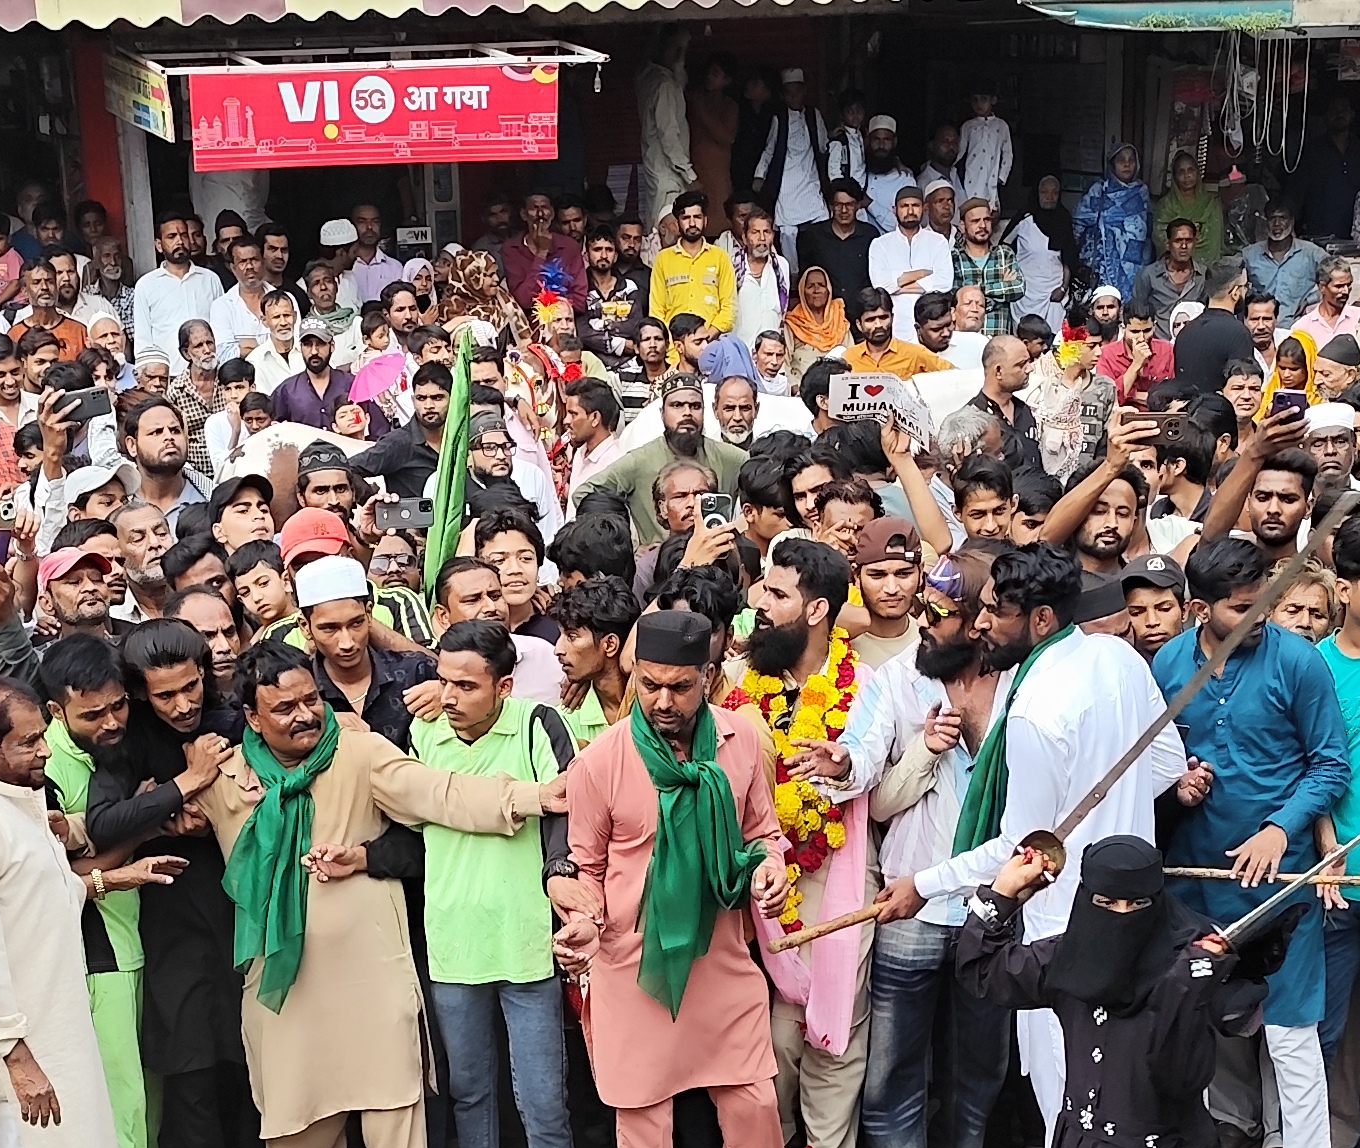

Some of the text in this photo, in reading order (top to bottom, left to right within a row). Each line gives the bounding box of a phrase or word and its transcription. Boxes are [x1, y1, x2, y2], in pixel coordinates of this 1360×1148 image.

[355, 88, 386, 110] 5G
[404, 86, 438, 111] आ
[443, 85, 490, 110] गया
[848, 383, 860, 400] I
